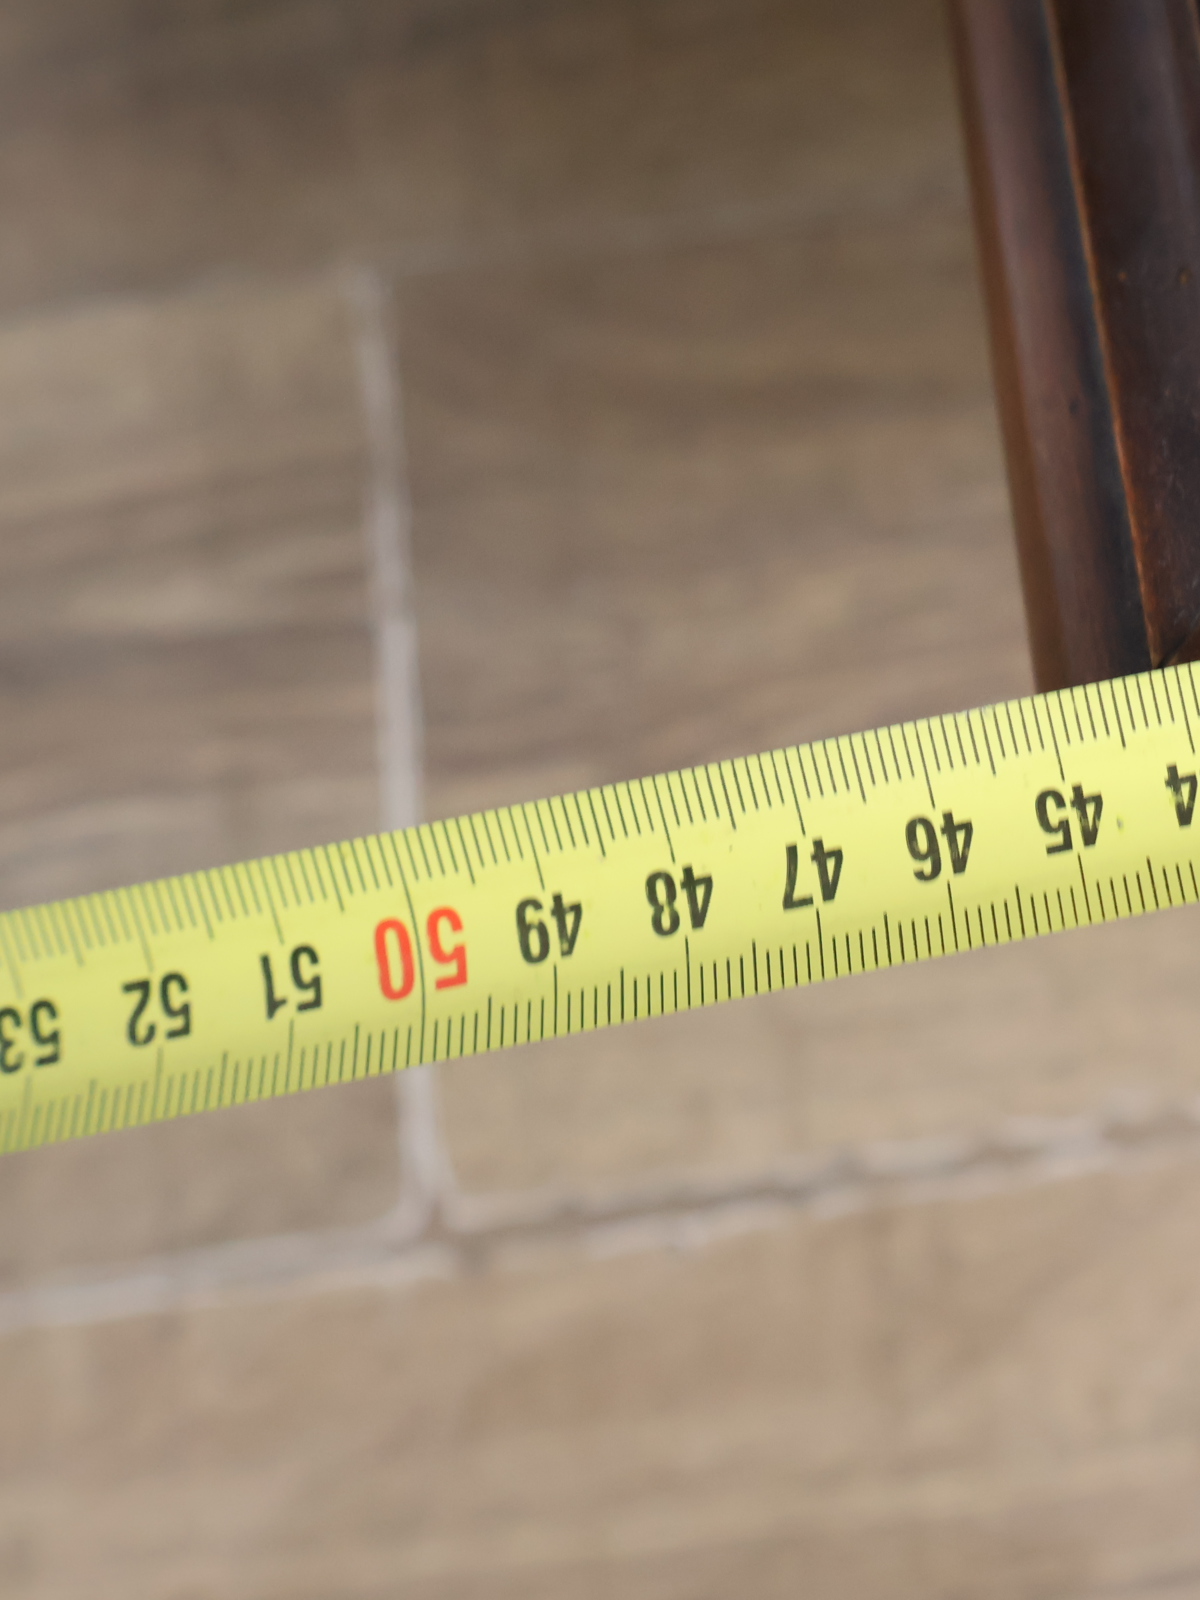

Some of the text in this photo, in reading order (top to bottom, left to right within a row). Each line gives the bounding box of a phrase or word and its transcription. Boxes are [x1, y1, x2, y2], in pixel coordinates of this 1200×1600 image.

[905, 811, 974, 882] 46
[1035, 783, 1104, 855] 45
[645, 865, 713, 937] 48
[782, 838, 844, 910] 47
[375, 906, 468, 1001] 50
[516, 892, 583, 964] 49
[122, 971, 191, 1046] 52
[261, 944, 322, 1019] 51
[0, 998, 60, 1074] 53
